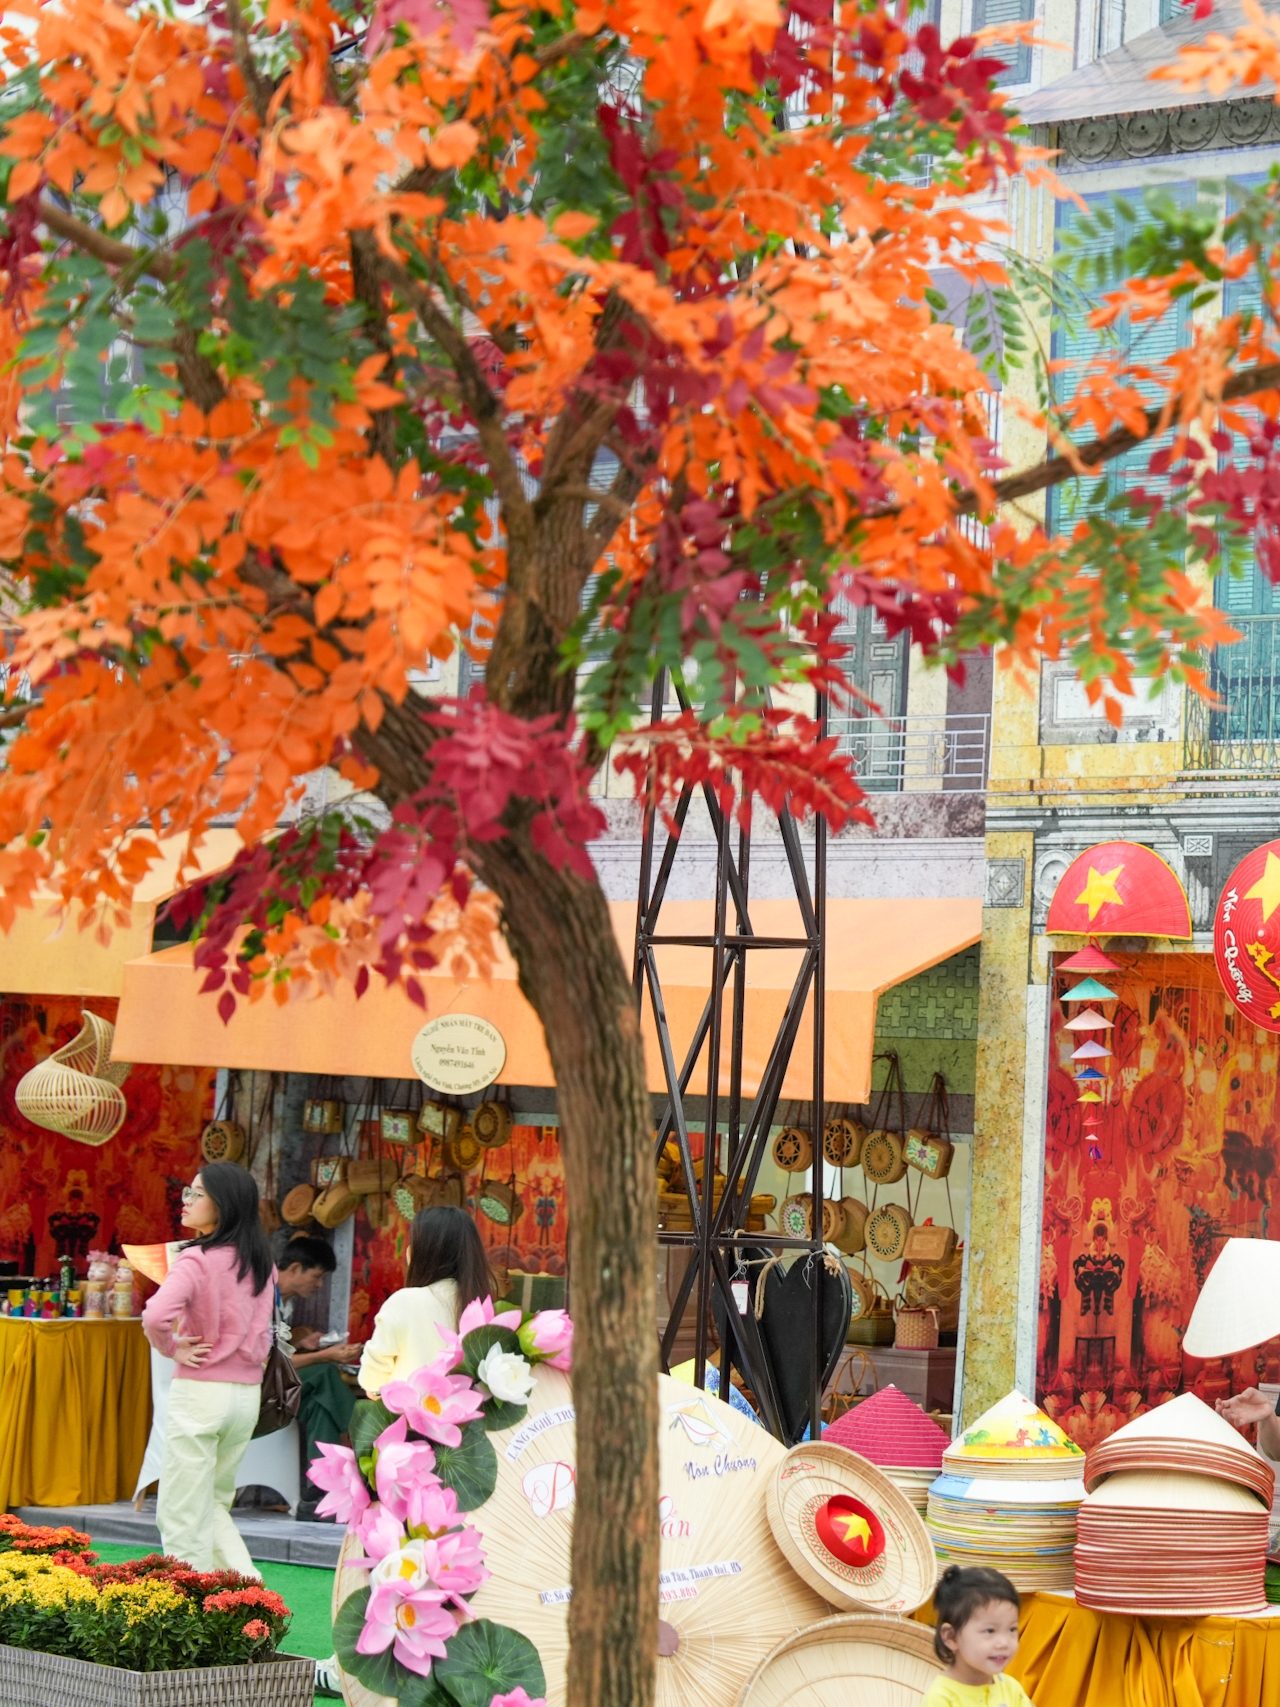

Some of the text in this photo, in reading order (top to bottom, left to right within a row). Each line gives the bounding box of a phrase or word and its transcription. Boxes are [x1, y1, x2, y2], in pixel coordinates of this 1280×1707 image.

[554, 1408, 577, 1421] TRU
[521, 1460, 577, 1518] P
[689, 1566, 714, 1580] Thanh
